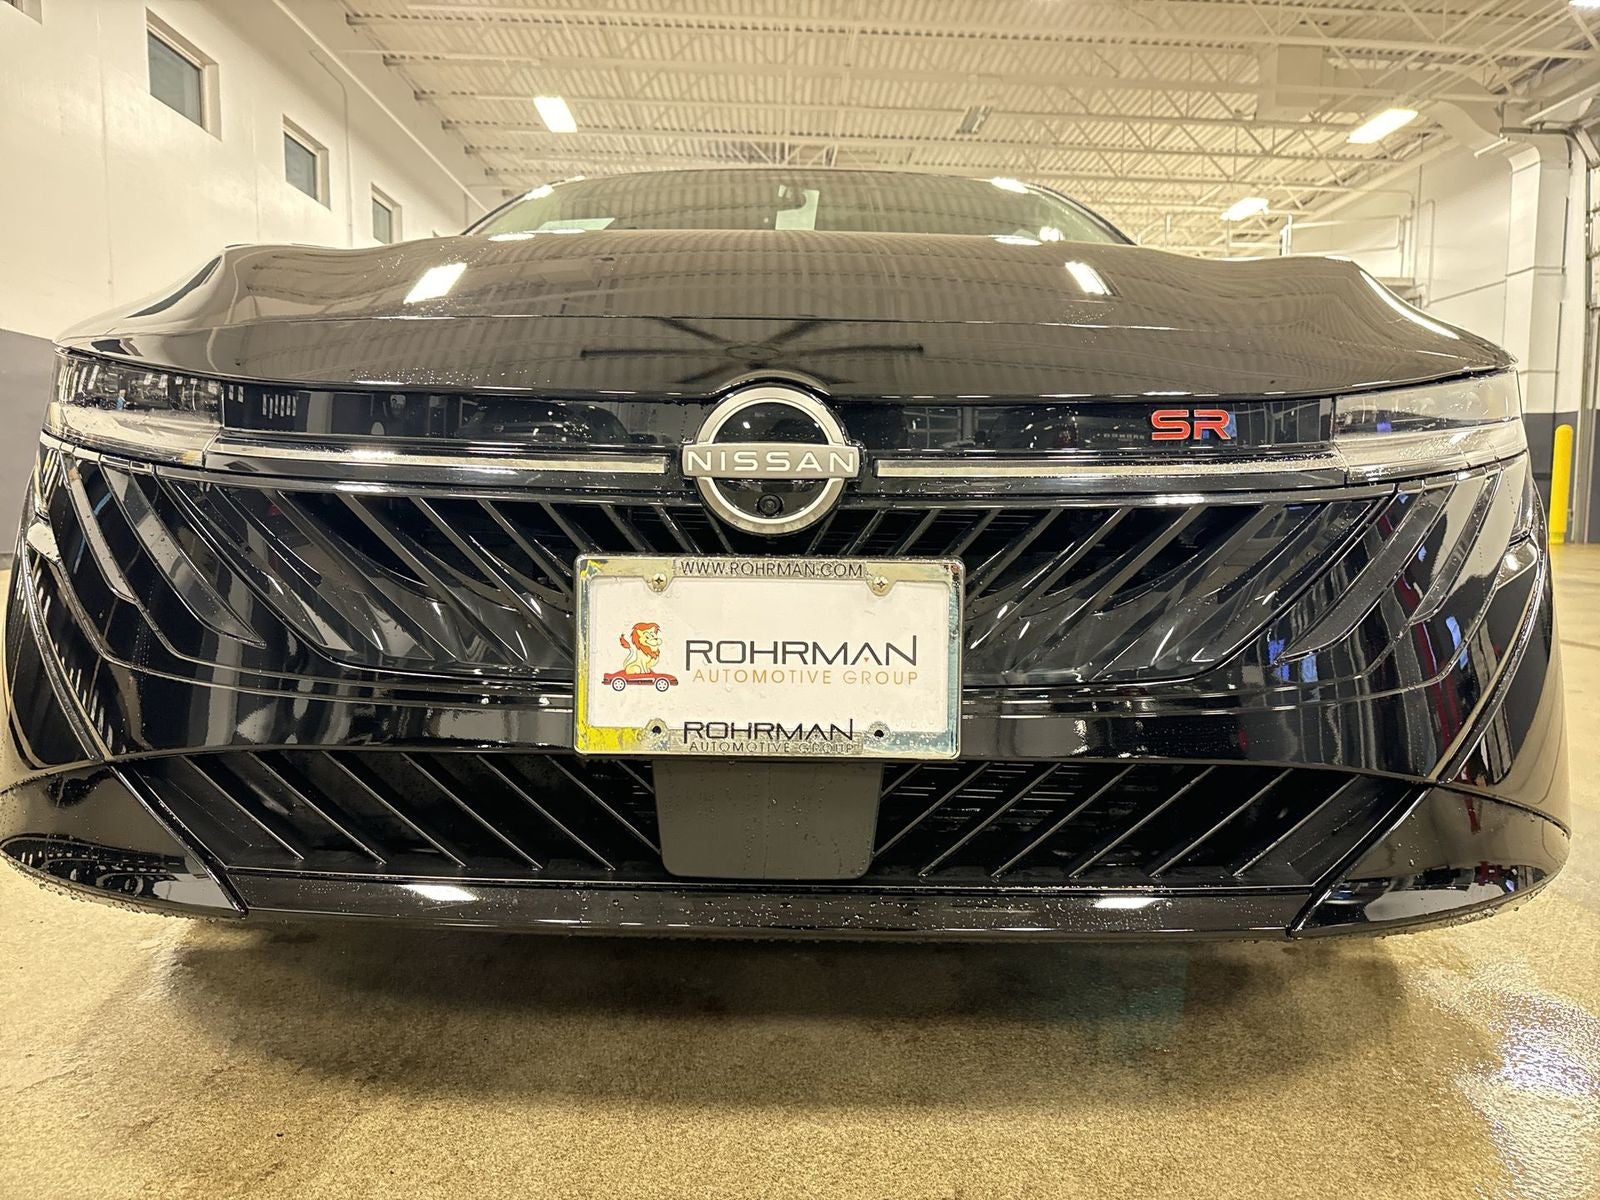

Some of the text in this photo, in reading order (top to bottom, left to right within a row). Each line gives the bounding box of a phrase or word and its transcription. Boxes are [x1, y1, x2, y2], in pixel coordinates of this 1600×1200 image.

[1151, 409, 1232, 441] SR
[687, 451, 854, 473] NISSAN
[681, 561, 863, 577] WWW.ROHRMAN.COM
[686, 635, 917, 671] ROHRMAN
[692, 669, 918, 686] AUTOMOTIVE GROUP
[683, 718, 853, 744] ROHRMAN
[689, 741, 855, 754] AUTOMOTIVE GROUP
